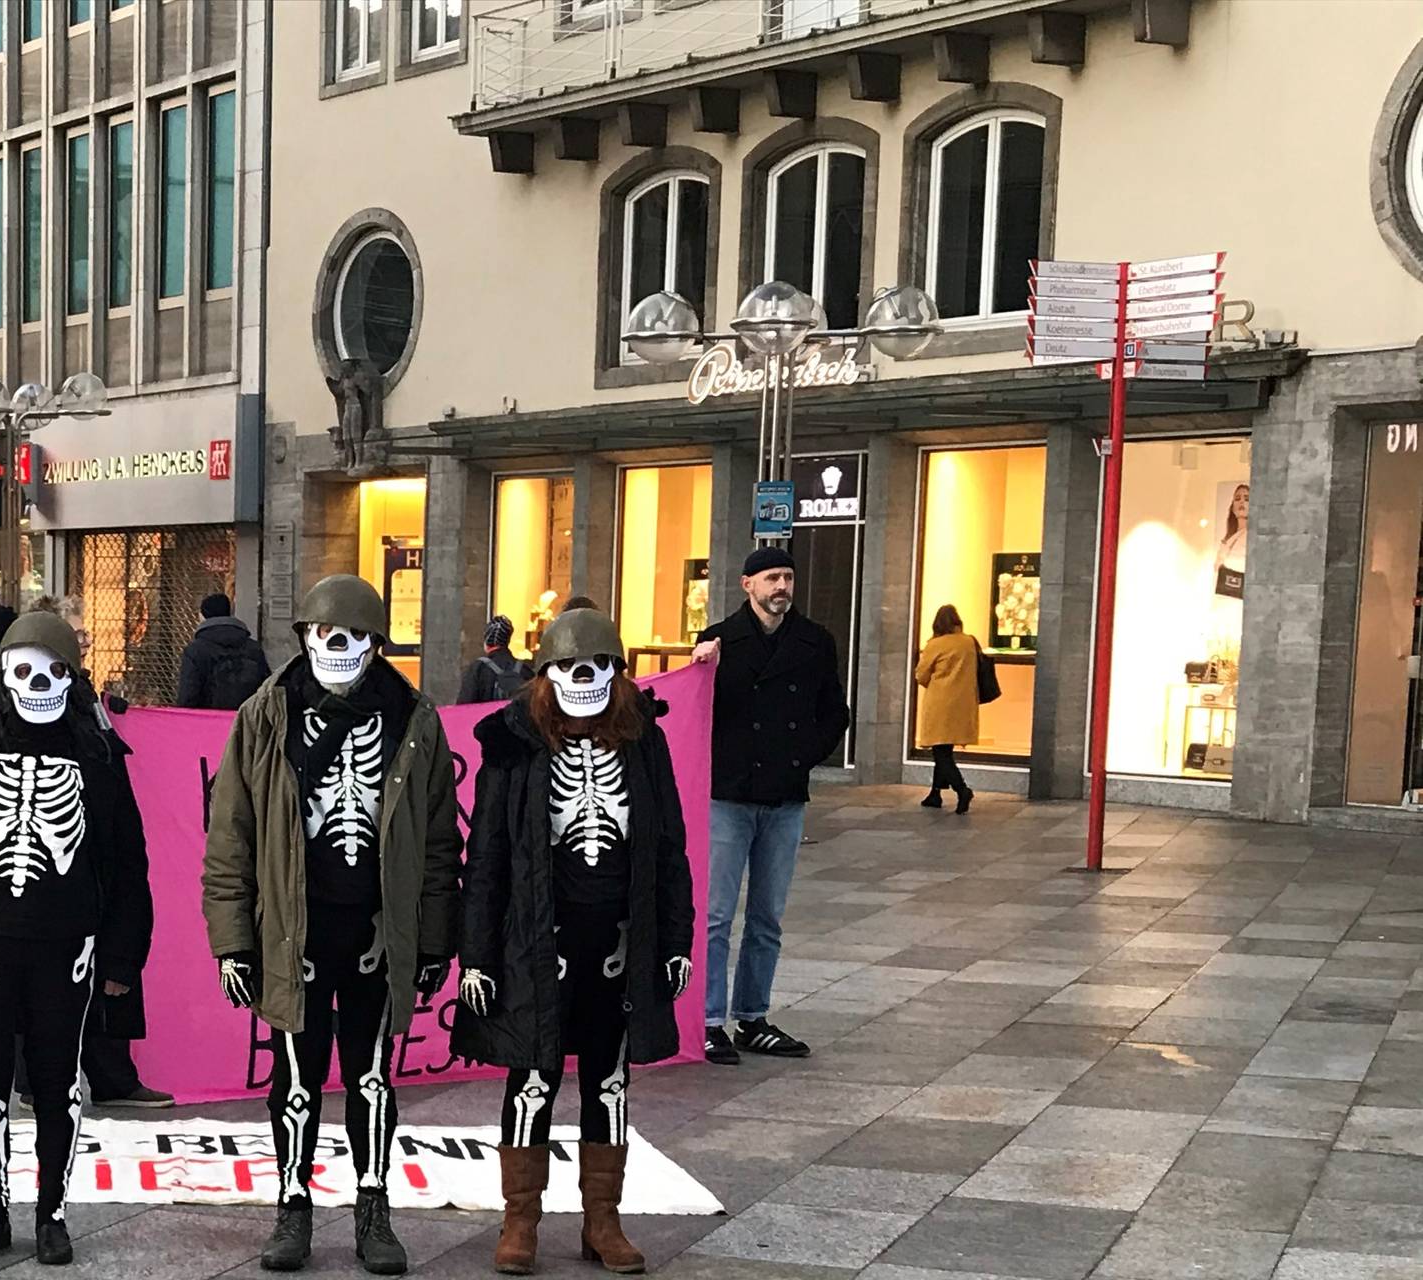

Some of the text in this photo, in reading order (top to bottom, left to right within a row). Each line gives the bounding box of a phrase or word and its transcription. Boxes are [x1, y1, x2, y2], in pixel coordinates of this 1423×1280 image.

[1049, 284, 1098, 296] Philharmonie
[1047, 304, 1076, 314] Altstadt
[42, 457, 102, 484] ZWILLING
[132, 449, 207, 478] HENCKELS
